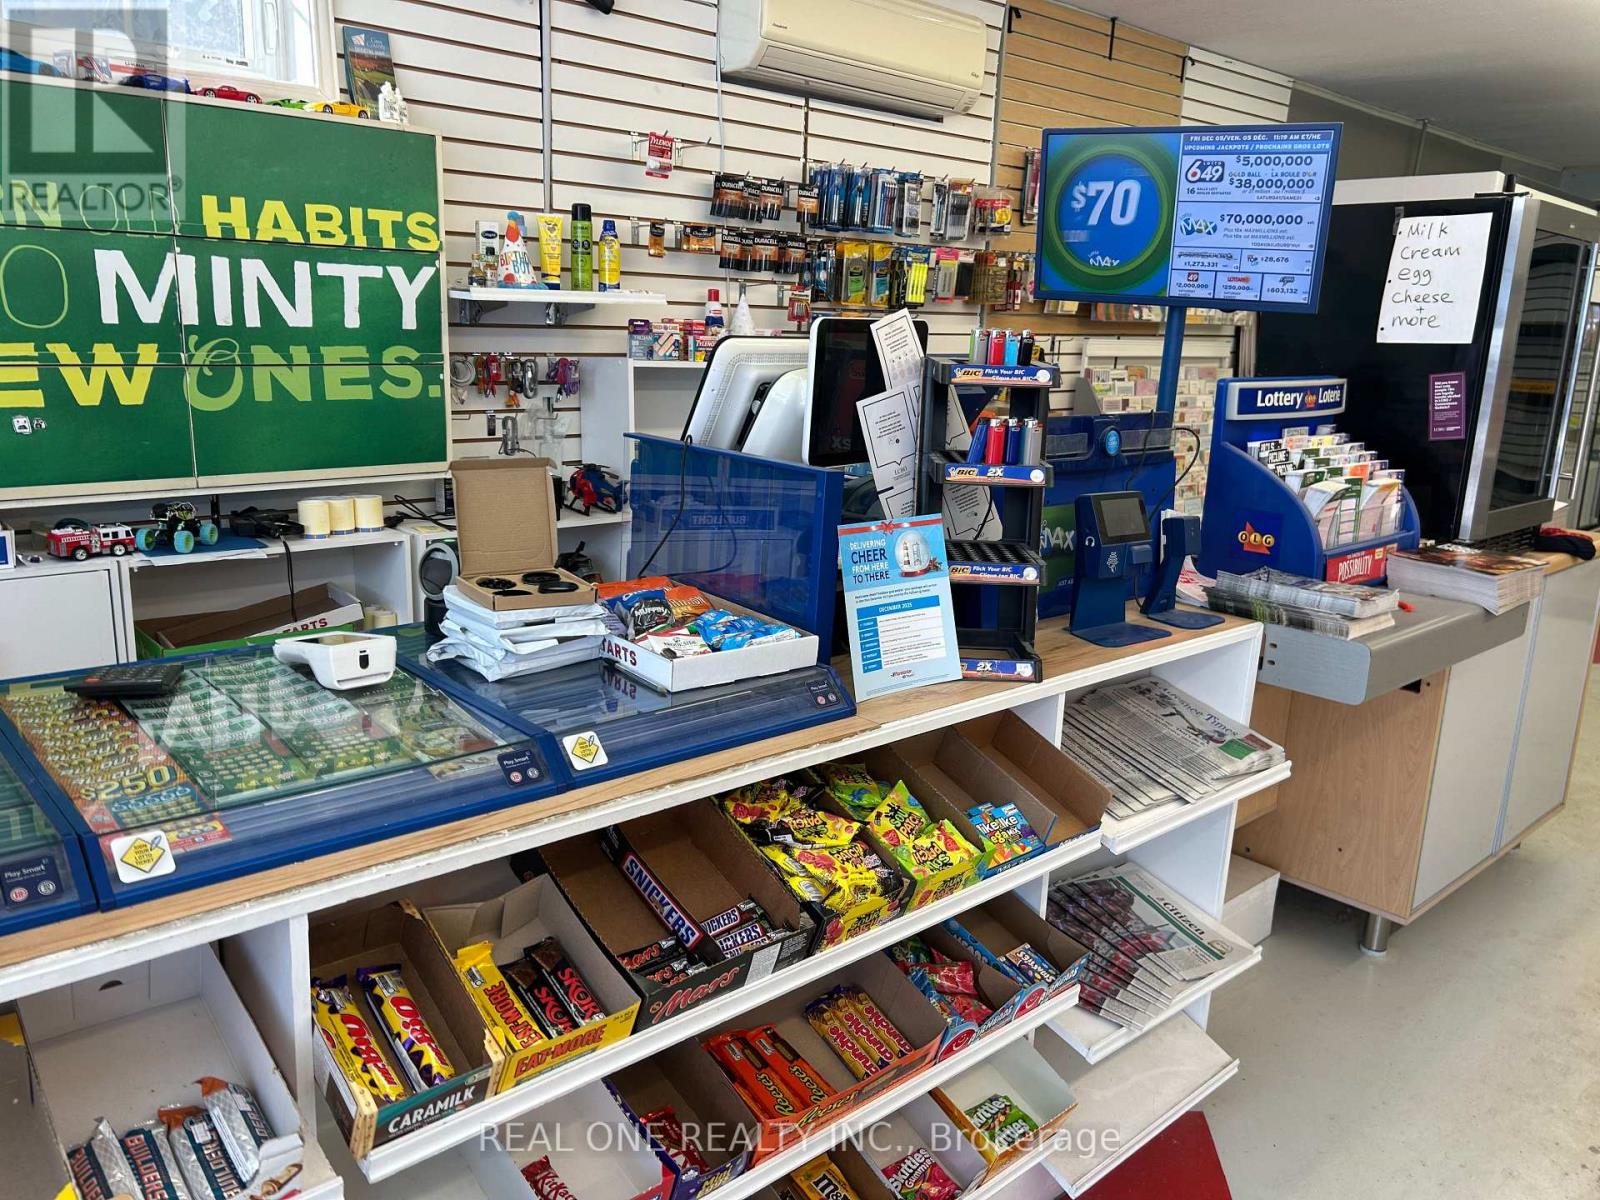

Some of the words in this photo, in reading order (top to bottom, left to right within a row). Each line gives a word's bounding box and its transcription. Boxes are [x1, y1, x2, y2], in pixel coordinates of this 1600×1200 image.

[1236, 155, 1313, 168] $5,000,000
[1187, 187, 1195, 195] 16
[1229, 178, 1315, 189] $38,000,000
[1071, 179, 1141, 226] $70
[79, 185, 180, 238] OLD
[201, 195, 441, 252] HABITS
[1220, 214, 1303, 226] $70,000,000
[1407, 222, 1448, 240] Milk
[755, 237, 778, 245] DURACELL
[1398, 266, 1432, 286] egg
[94, 247, 437, 331] MINTY
[1391, 314, 1441, 329] more
[1256, 390, 1302, 409] Lottery
[987, 468, 1004, 477] 2X
[849, 538, 886, 551] DELIVERING
[851, 548, 888, 565] CHEER
[852, 564, 871, 574] FROM
[871, 561, 889, 571] HERE
[853, 574, 865, 585] TO
[866, 570, 890, 582] THERE
[976, 662, 993, 671] 2X
[1205, 713, 1240, 737] Times
[80, 765, 177, 800] $250
[4, 871, 21, 879] Play
[22, 864, 46, 875] Smart
[625, 857, 698, 947] SNICKERS
[1162, 901, 1205, 937] Citizen
[1016, 950, 1056, 983] SMARTIES
[651, 965, 740, 1025] Mars
[483, 980, 545, 1049] EAT-MORE
[513, 1022, 607, 1079] EAT-MORE
[388, 1085, 476, 1136] CARAMILK
[889, 1148, 933, 1191] Skittles
[904, 1157, 936, 1188] Gummies
